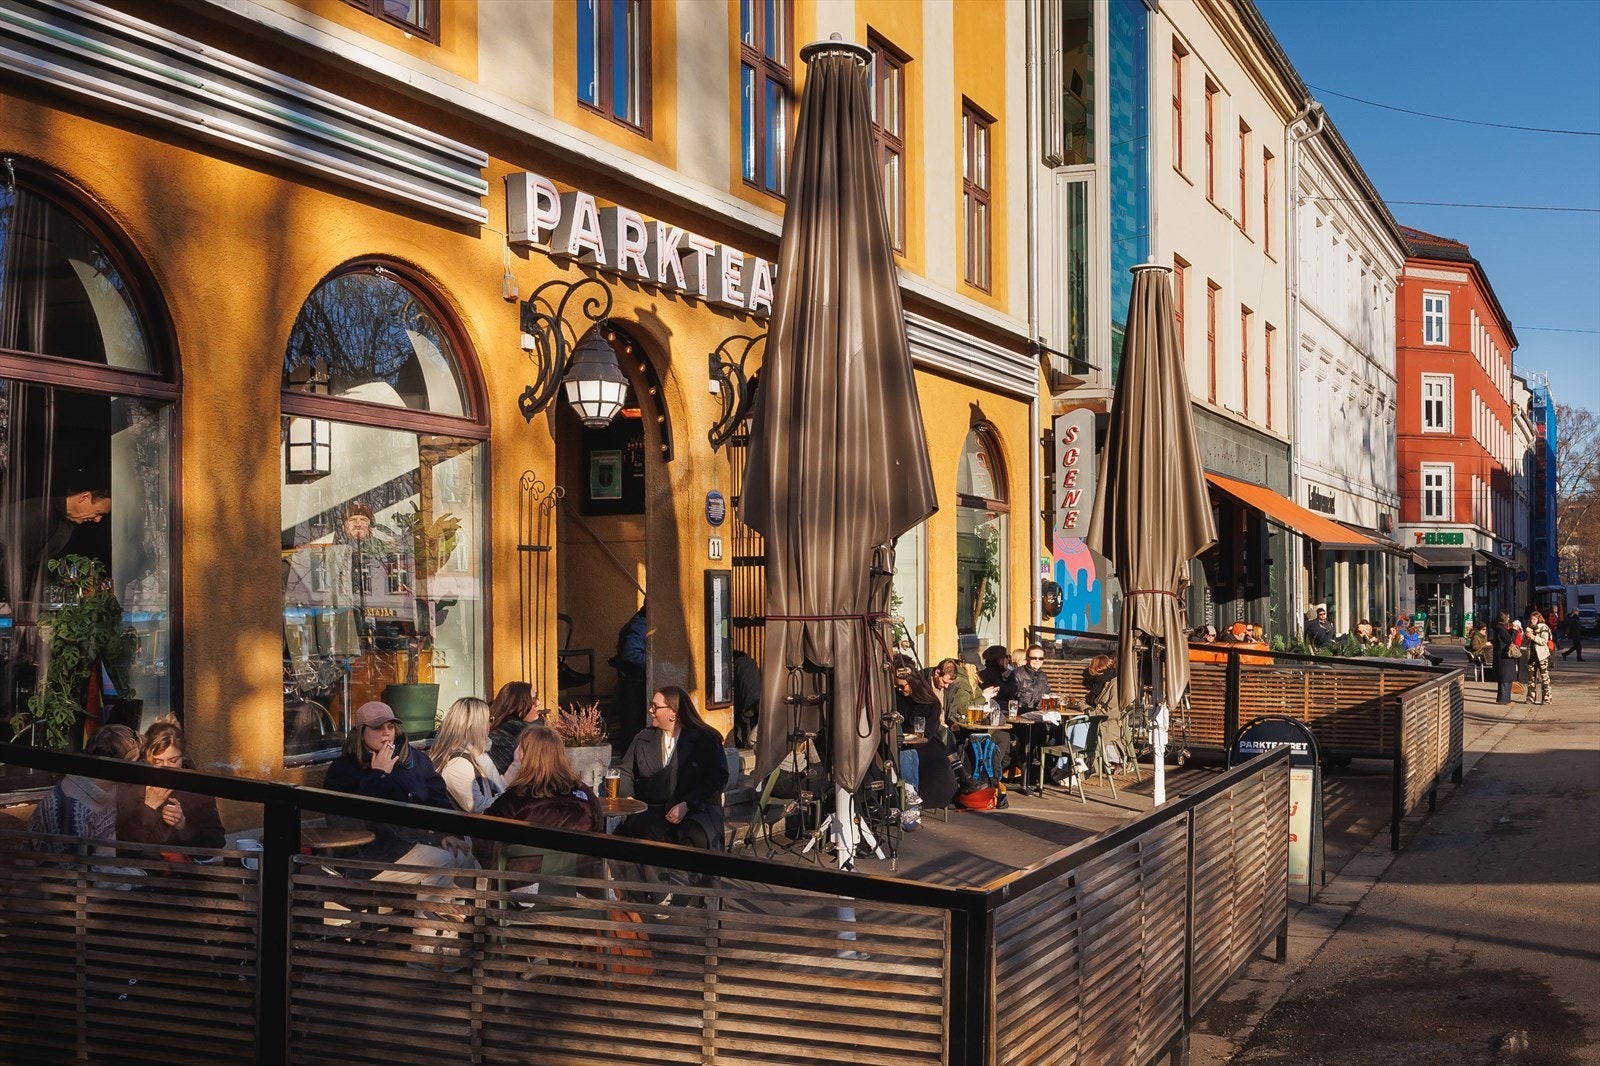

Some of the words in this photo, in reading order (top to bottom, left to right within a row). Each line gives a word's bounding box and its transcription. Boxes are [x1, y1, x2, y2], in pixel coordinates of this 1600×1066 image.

[526, 171, 778, 316] PARKTEA
[1062, 425, 1083, 530] SCENE
[712, 541, 720, 556] 11
[1239, 741, 1308, 750] PARKTERET
